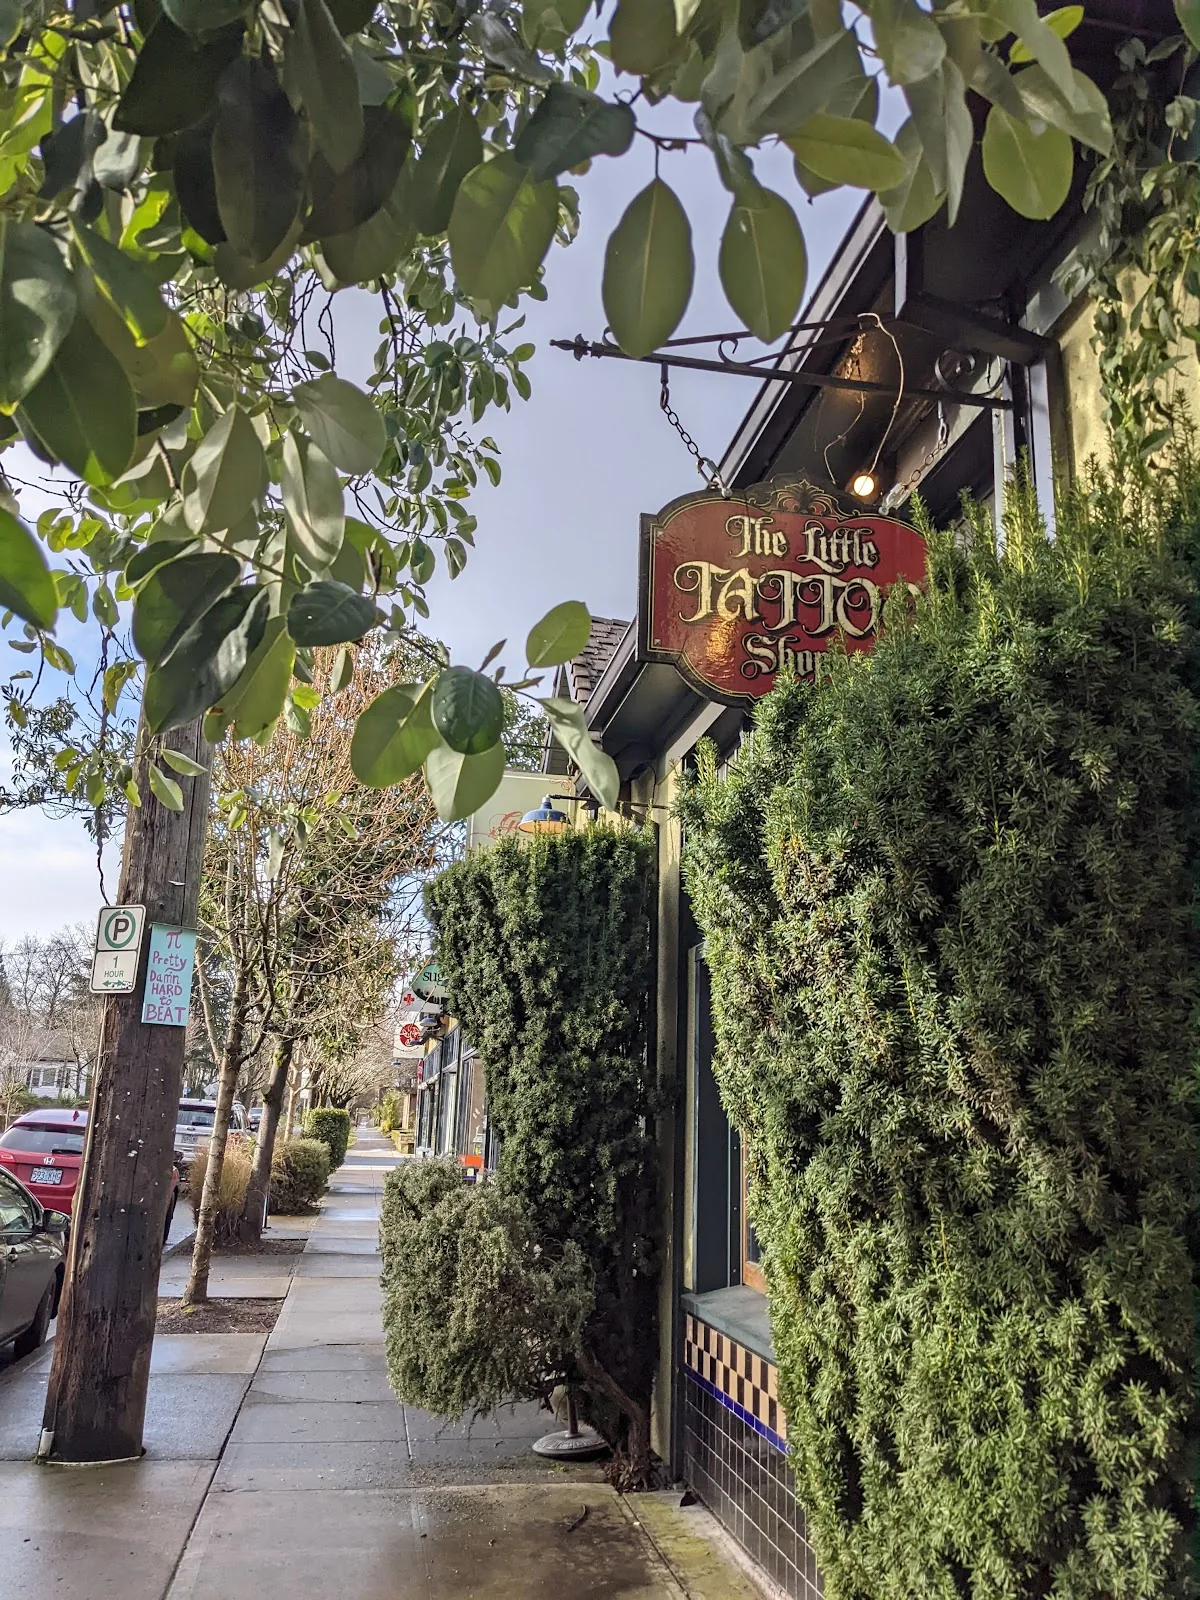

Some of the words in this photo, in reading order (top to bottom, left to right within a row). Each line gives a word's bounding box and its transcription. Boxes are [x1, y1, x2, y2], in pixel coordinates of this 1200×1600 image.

[725, 514, 788, 558] The
[797, 520, 879, 573] Little
[113, 918, 130, 941] P
[112, 956, 119, 968] 1
[152, 951, 187, 972] Pretty
[104, 970, 125, 978] HOUR
[149, 971, 180, 984] Damn
[151, 983, 183, 996] HARD
[160, 994, 172, 1006] to
[146, 1003, 187, 1023] BEAT
